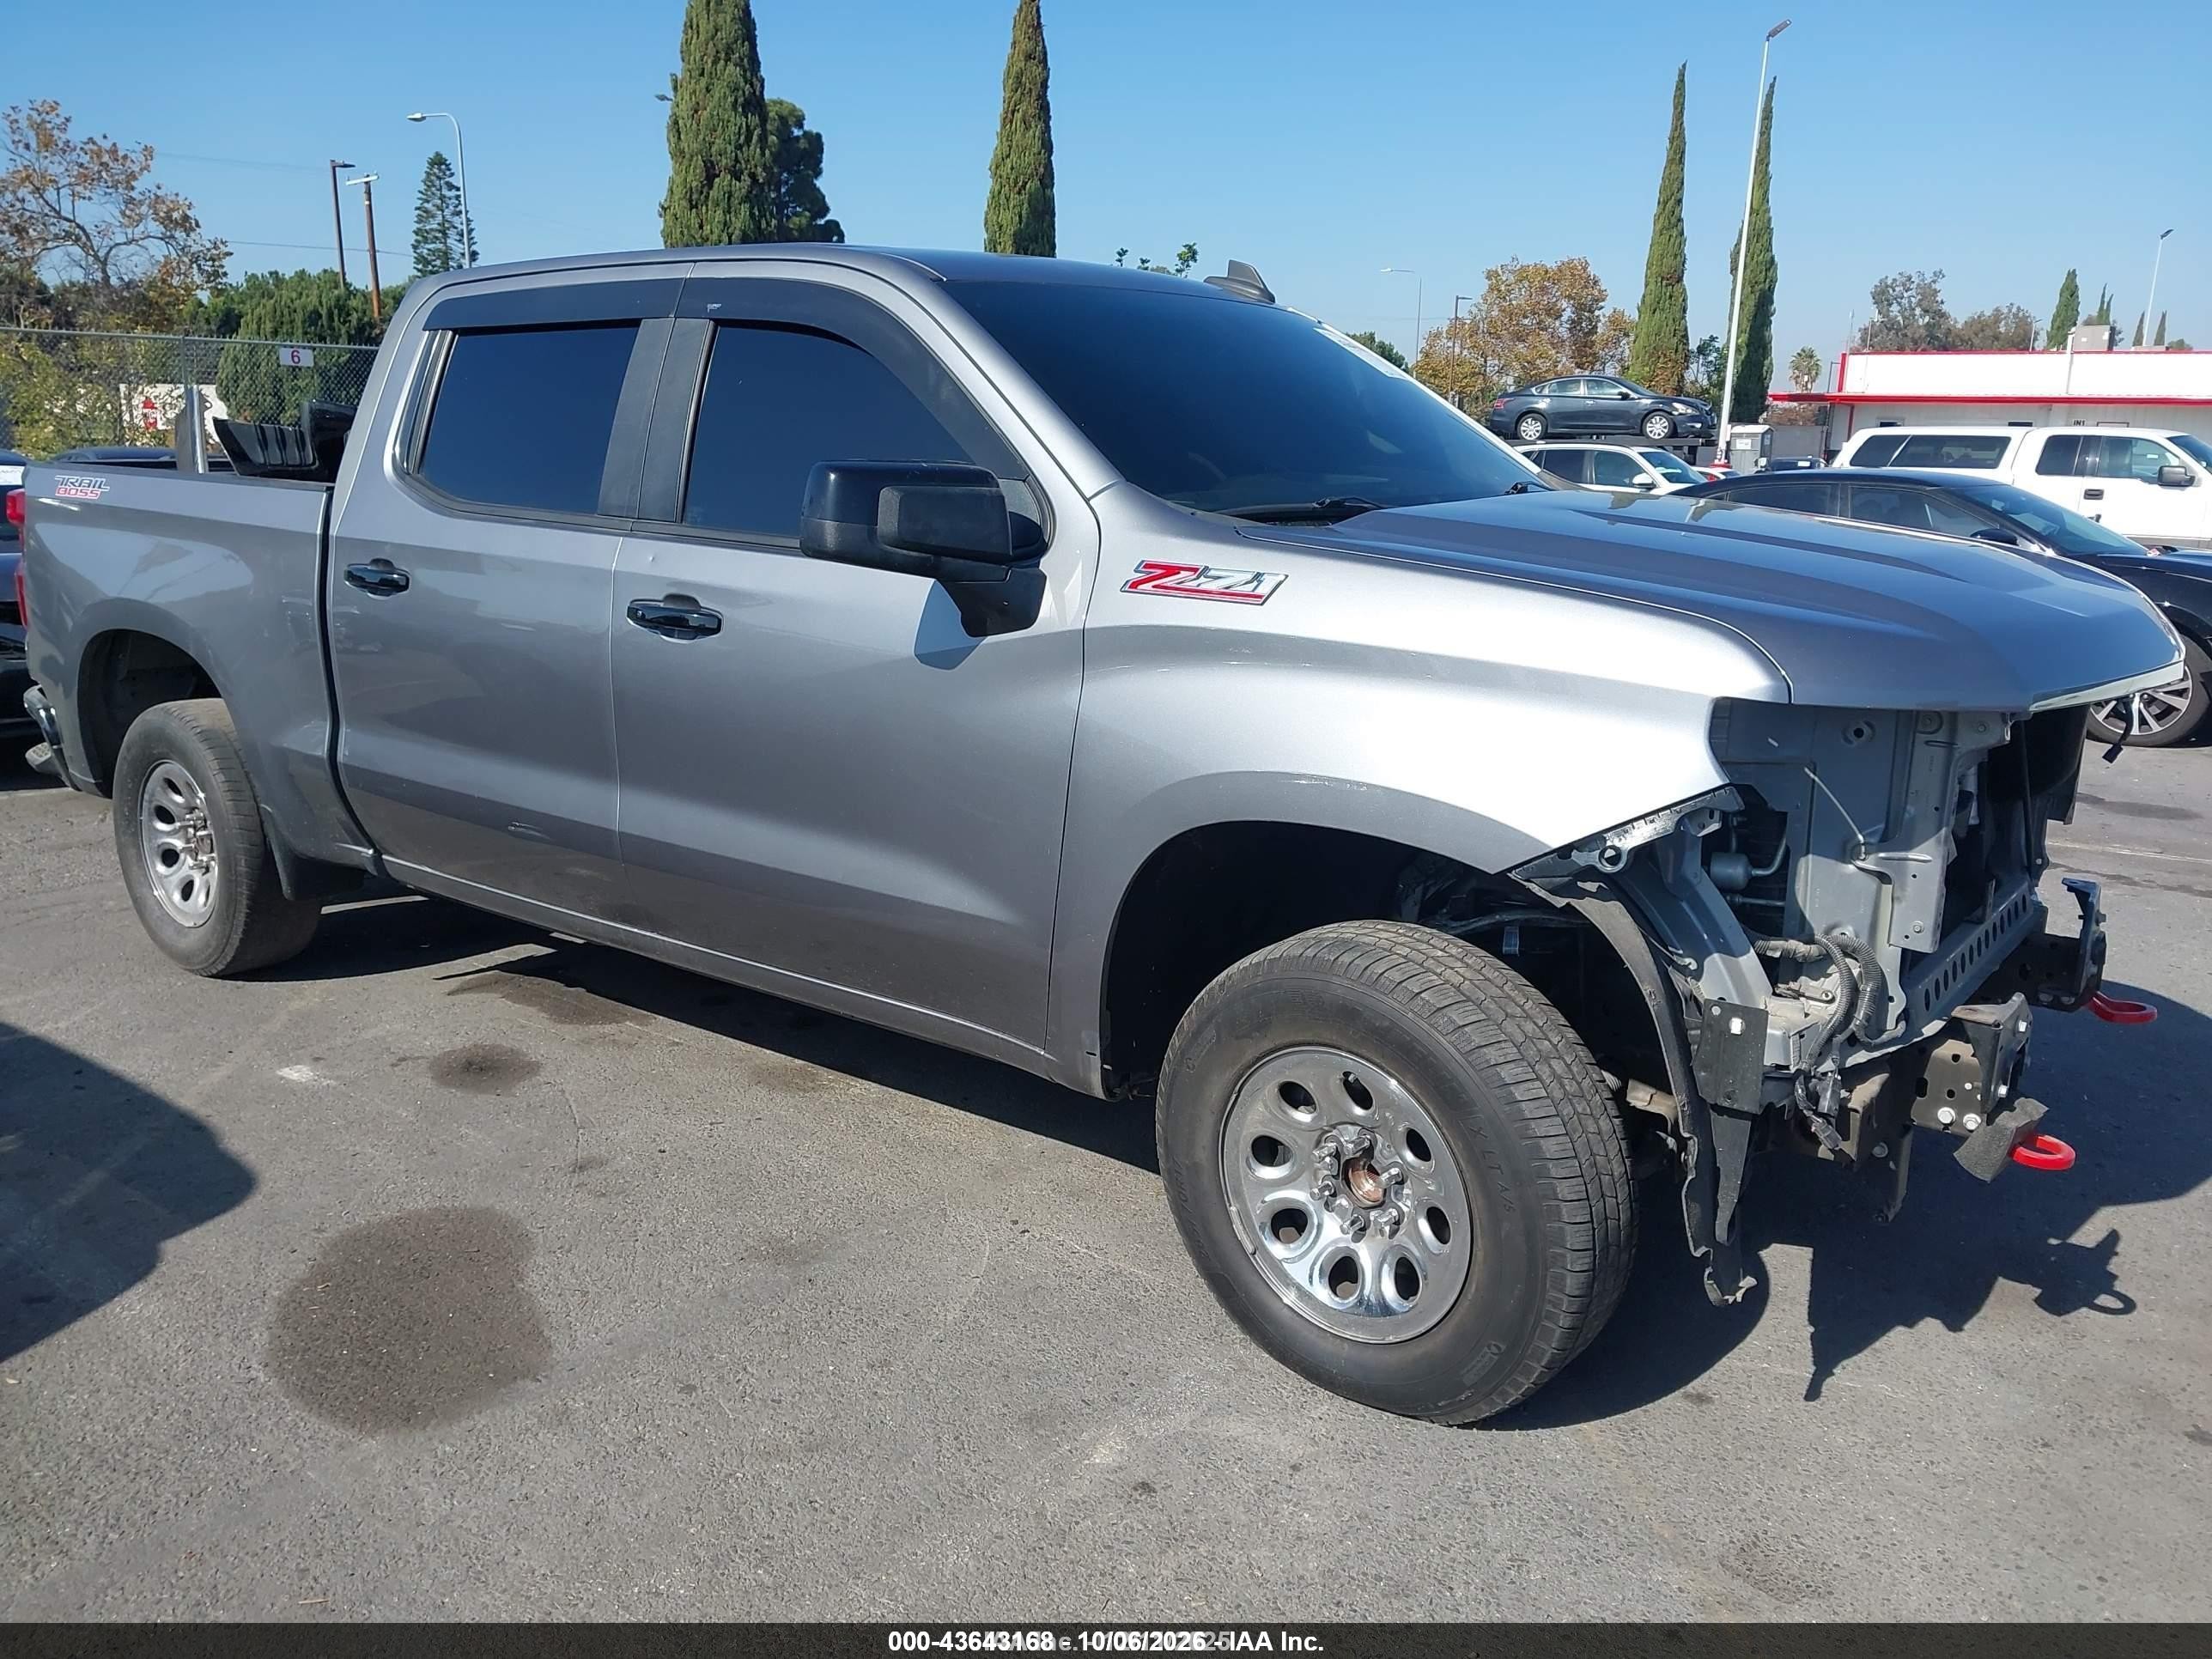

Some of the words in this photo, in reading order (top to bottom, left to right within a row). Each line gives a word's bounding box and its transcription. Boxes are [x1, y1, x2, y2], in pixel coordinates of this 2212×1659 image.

[291, 349, 301, 365] 6
[55, 475, 111, 492] TRAIL
[55, 487, 101, 500] BOSS
[1120, 559, 1289, 606] Z71
